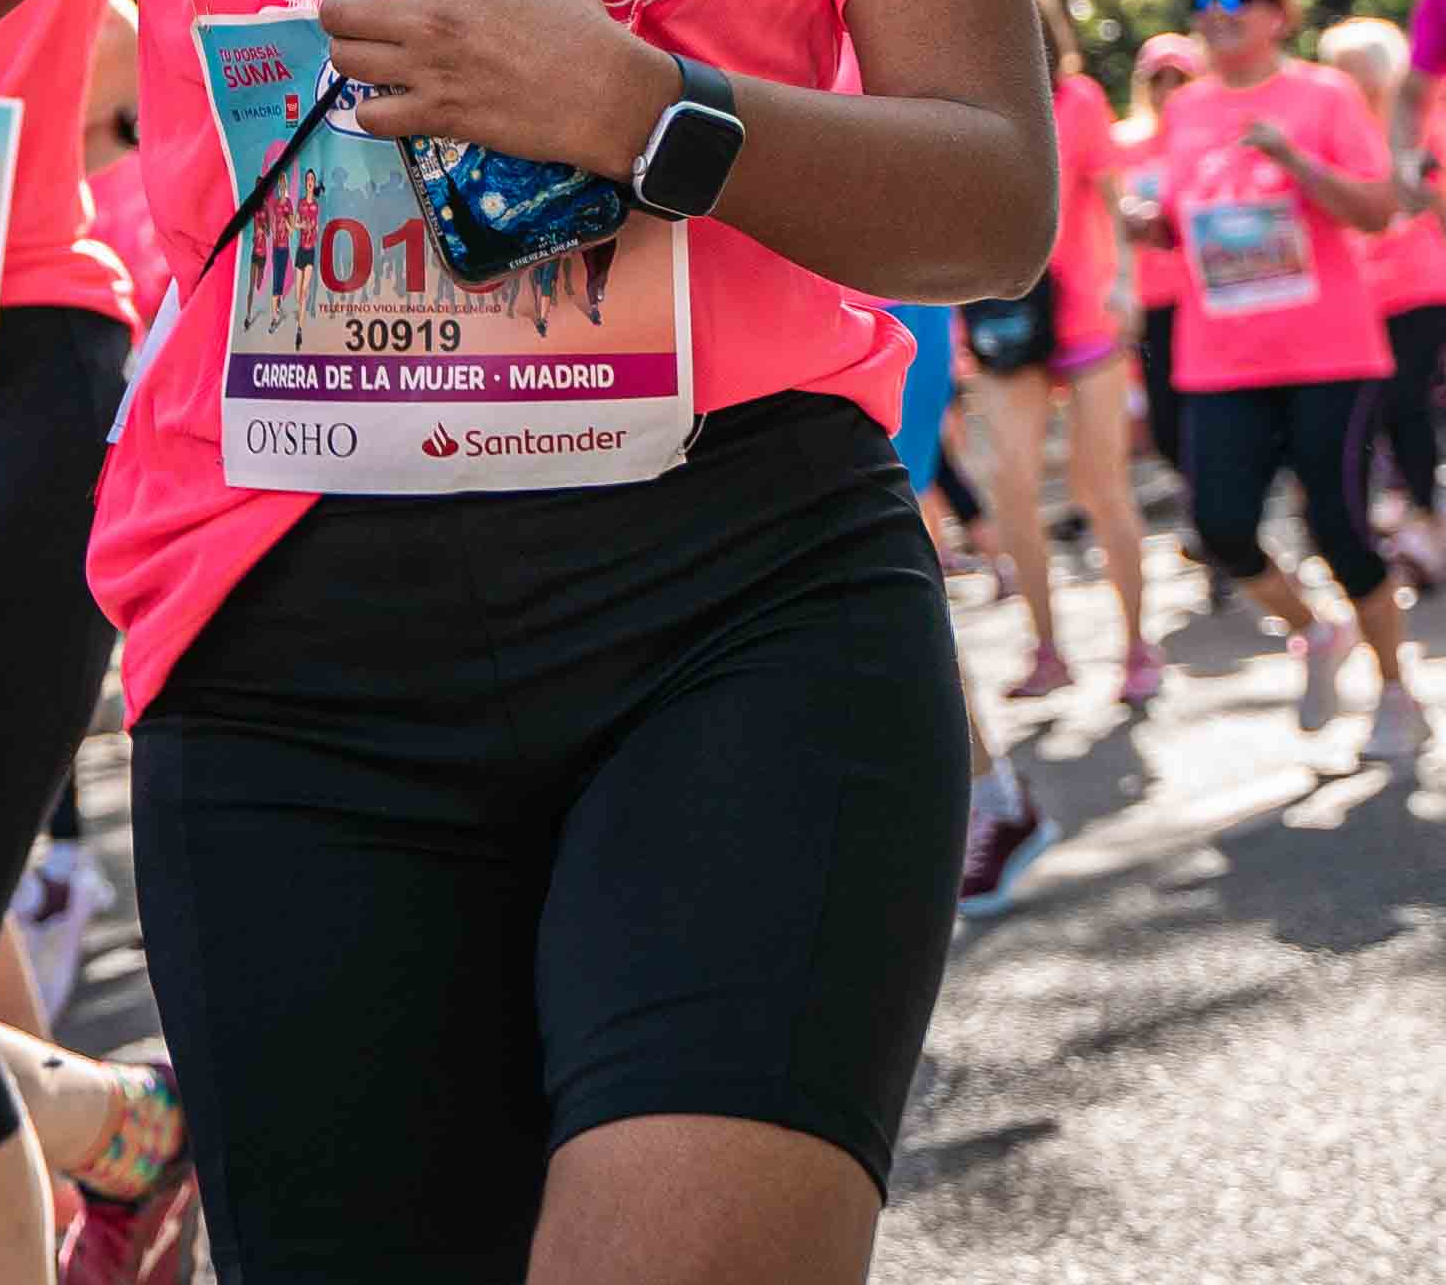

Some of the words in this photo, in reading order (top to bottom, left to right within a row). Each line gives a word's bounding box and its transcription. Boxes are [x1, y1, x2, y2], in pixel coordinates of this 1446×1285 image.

[223, 60, 294, 89] SUMA
[318, 217, 505, 295] 01
[372, 303, 434, 314] VIOLENCIA
[344, 317, 462, 352] 30919
[252, 363, 319, 390] CARRERA
[325, 364, 353, 389] DE
[360, 365, 391, 391] LA
[400, 365, 486, 391] MUJER
[509, 363, 615, 389] MADRID
[246, 418, 359, 458] OYSHO
[464, 428, 627, 457] Santander
